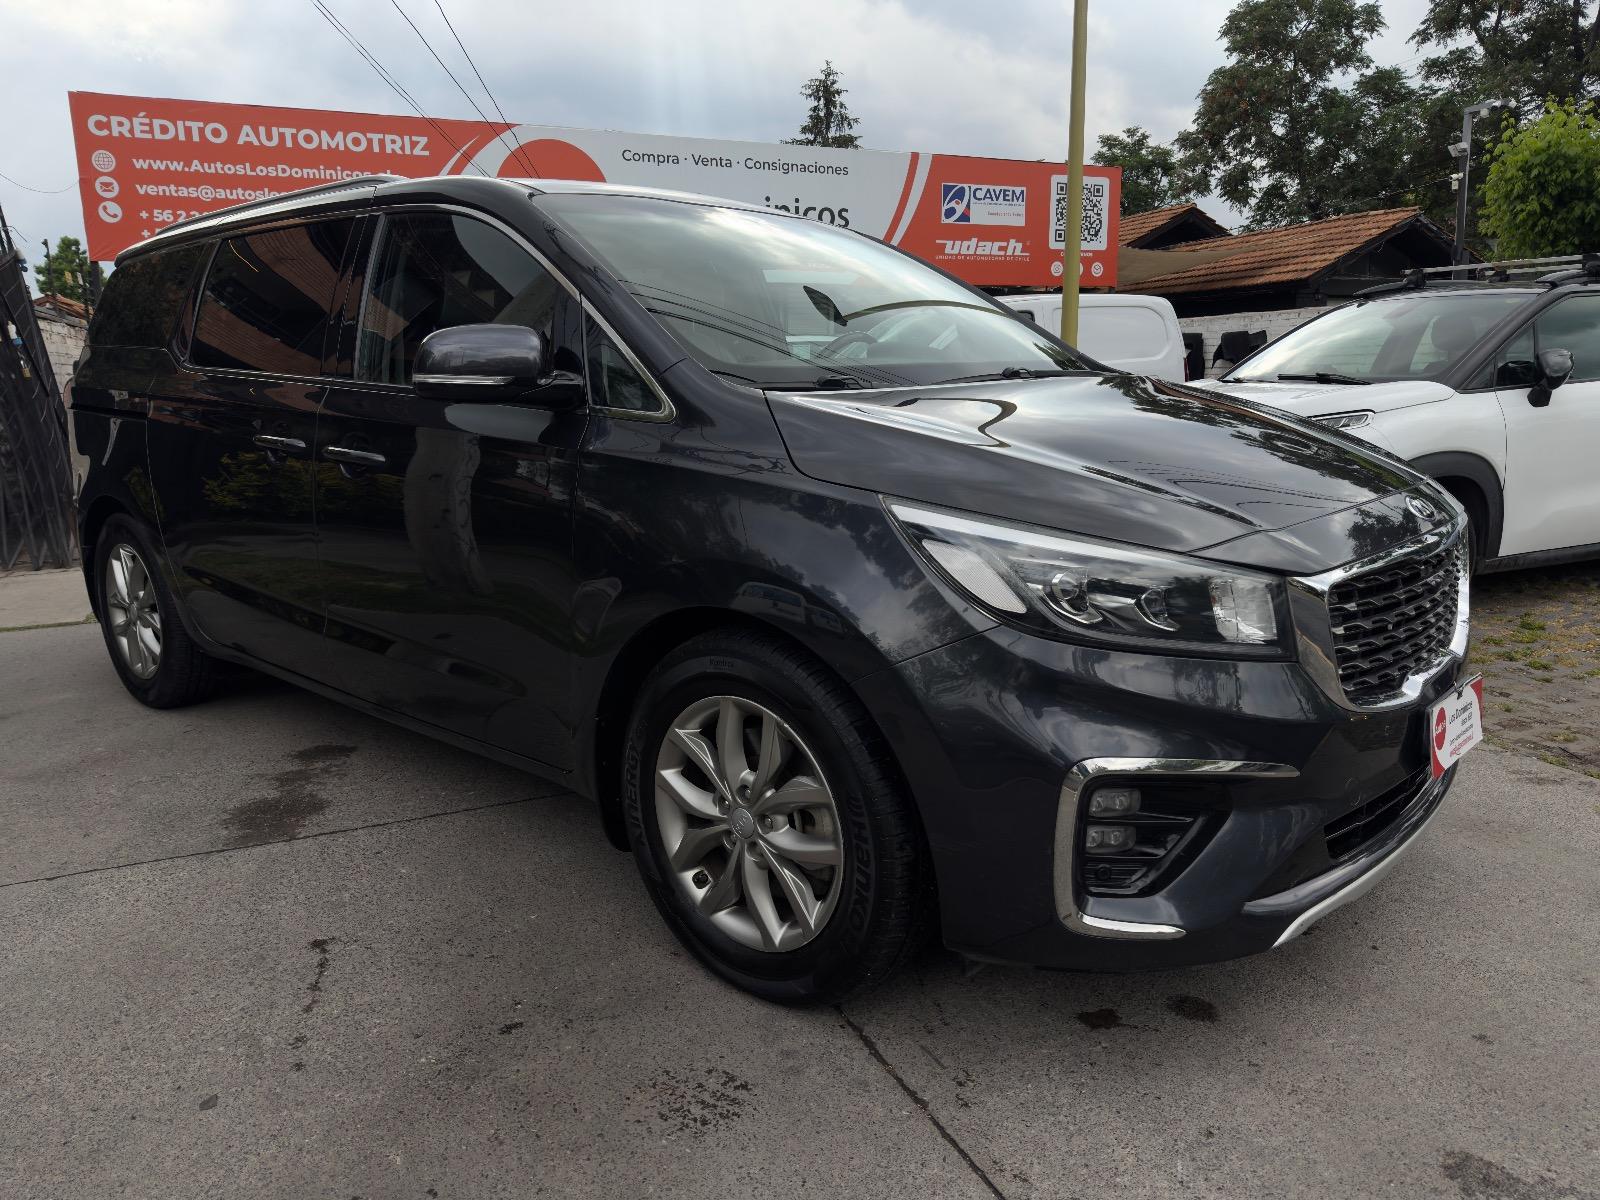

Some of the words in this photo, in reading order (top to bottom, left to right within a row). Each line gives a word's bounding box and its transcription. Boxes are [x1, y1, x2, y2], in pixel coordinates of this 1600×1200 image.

[87, 112, 228, 145] CRÉDITO
[237, 125, 430, 157] AUTOMOTRIZ
[621, 149, 680, 168] Compra
[692, 153, 733, 168] Venta
[744, 157, 849, 176] Consignaciones
[972, 187, 1025, 203] CAVEM
[153, 209, 173, 222] 56
[935, 237, 1031, 256] udach
